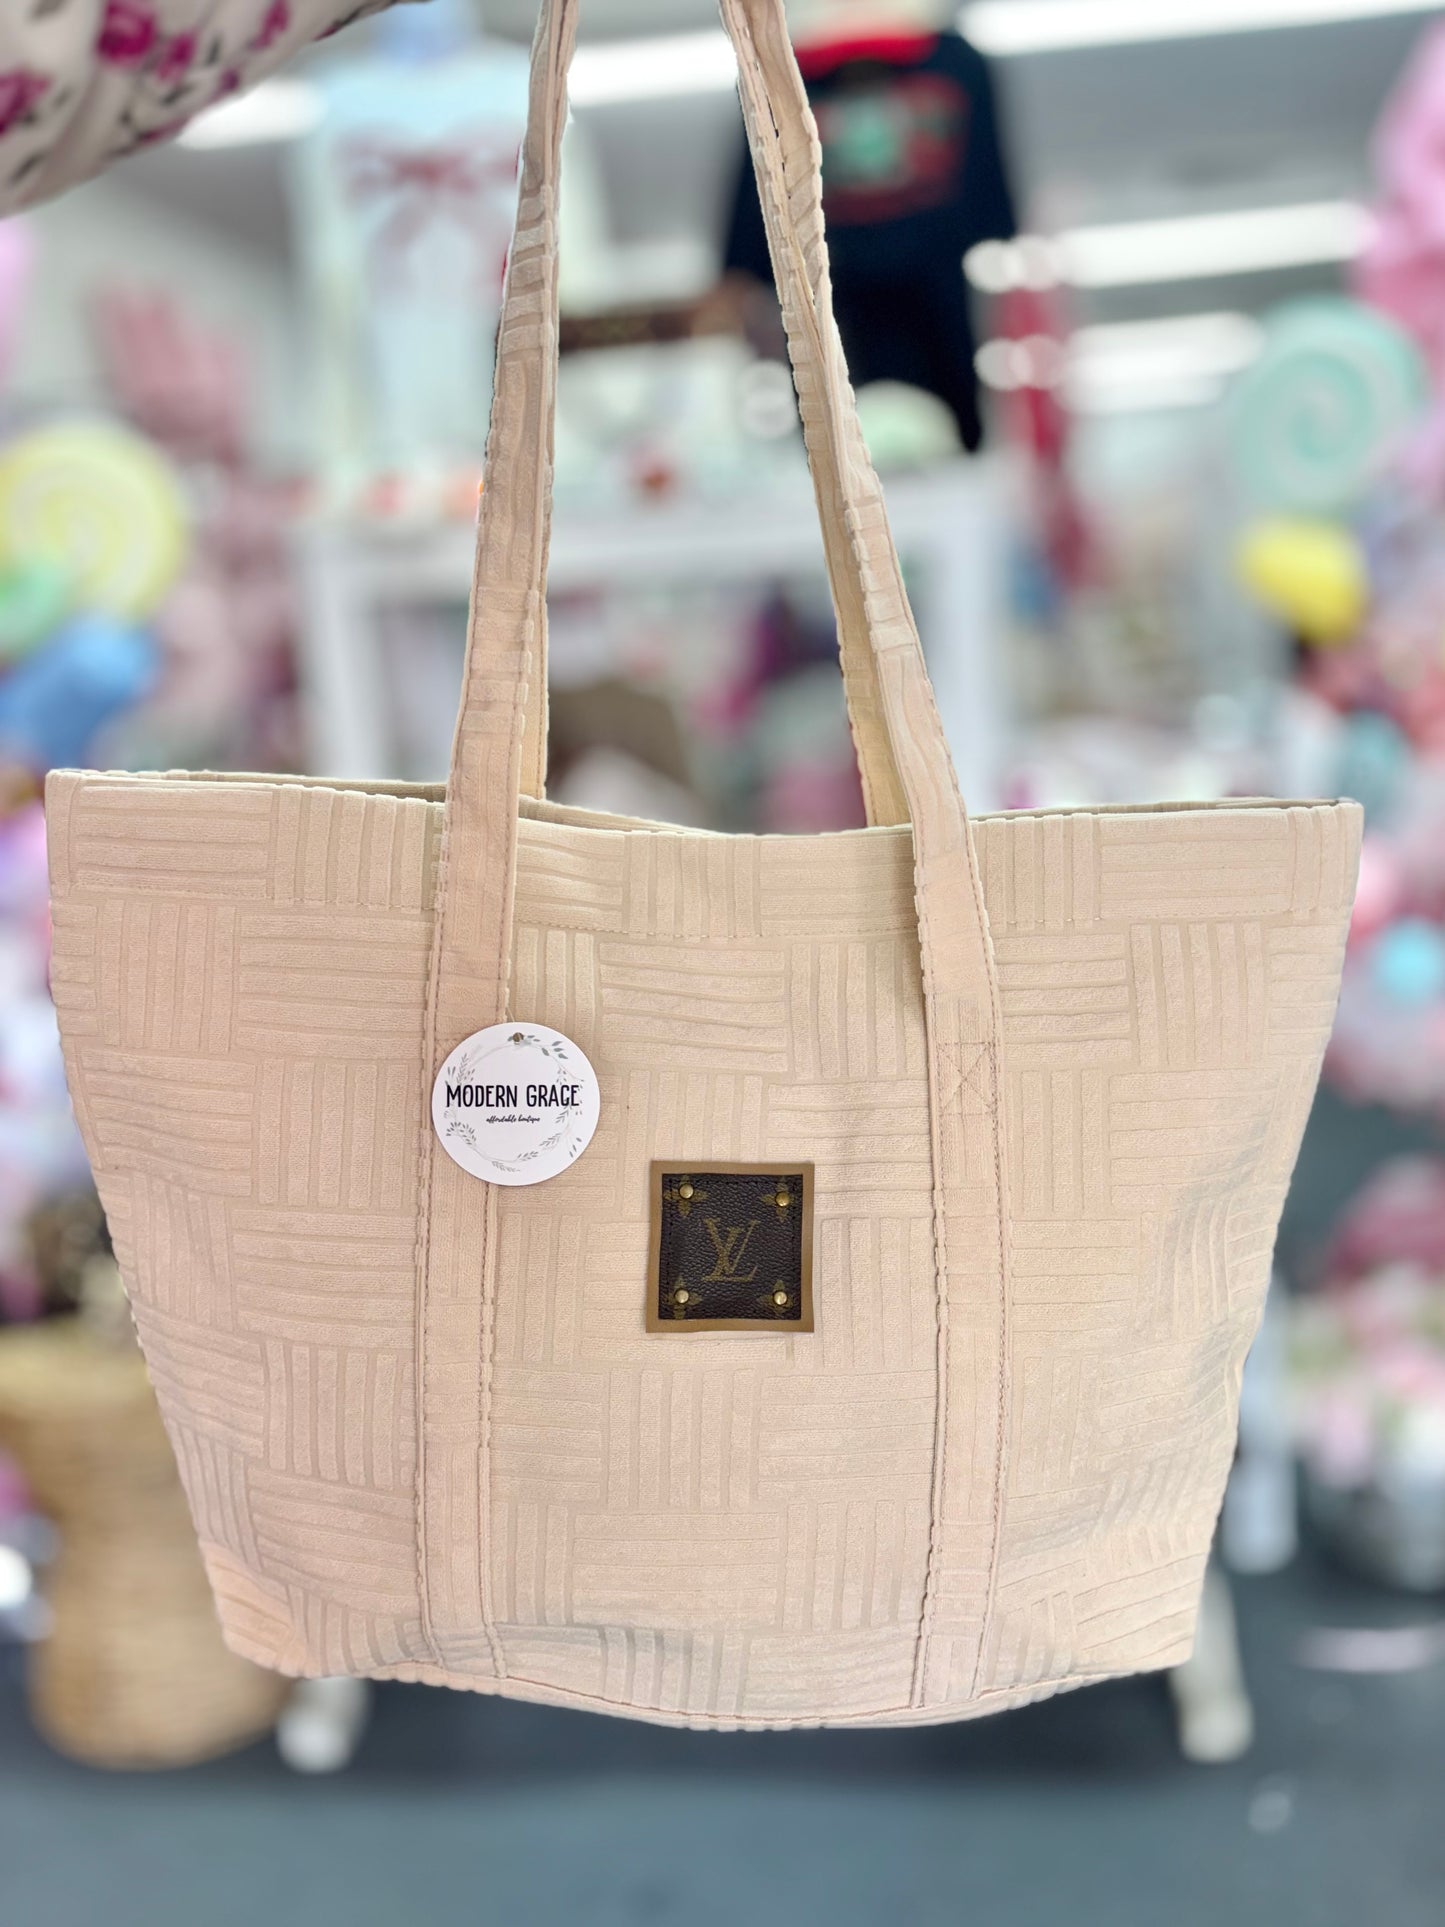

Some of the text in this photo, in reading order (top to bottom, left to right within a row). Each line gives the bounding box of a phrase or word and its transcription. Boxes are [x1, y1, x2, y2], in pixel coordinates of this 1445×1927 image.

[446, 1085, 579, 1108] MODERN GRACE
[486, 1114, 540, 1123] affordable boutique
[702, 1218, 760, 1282] LV
